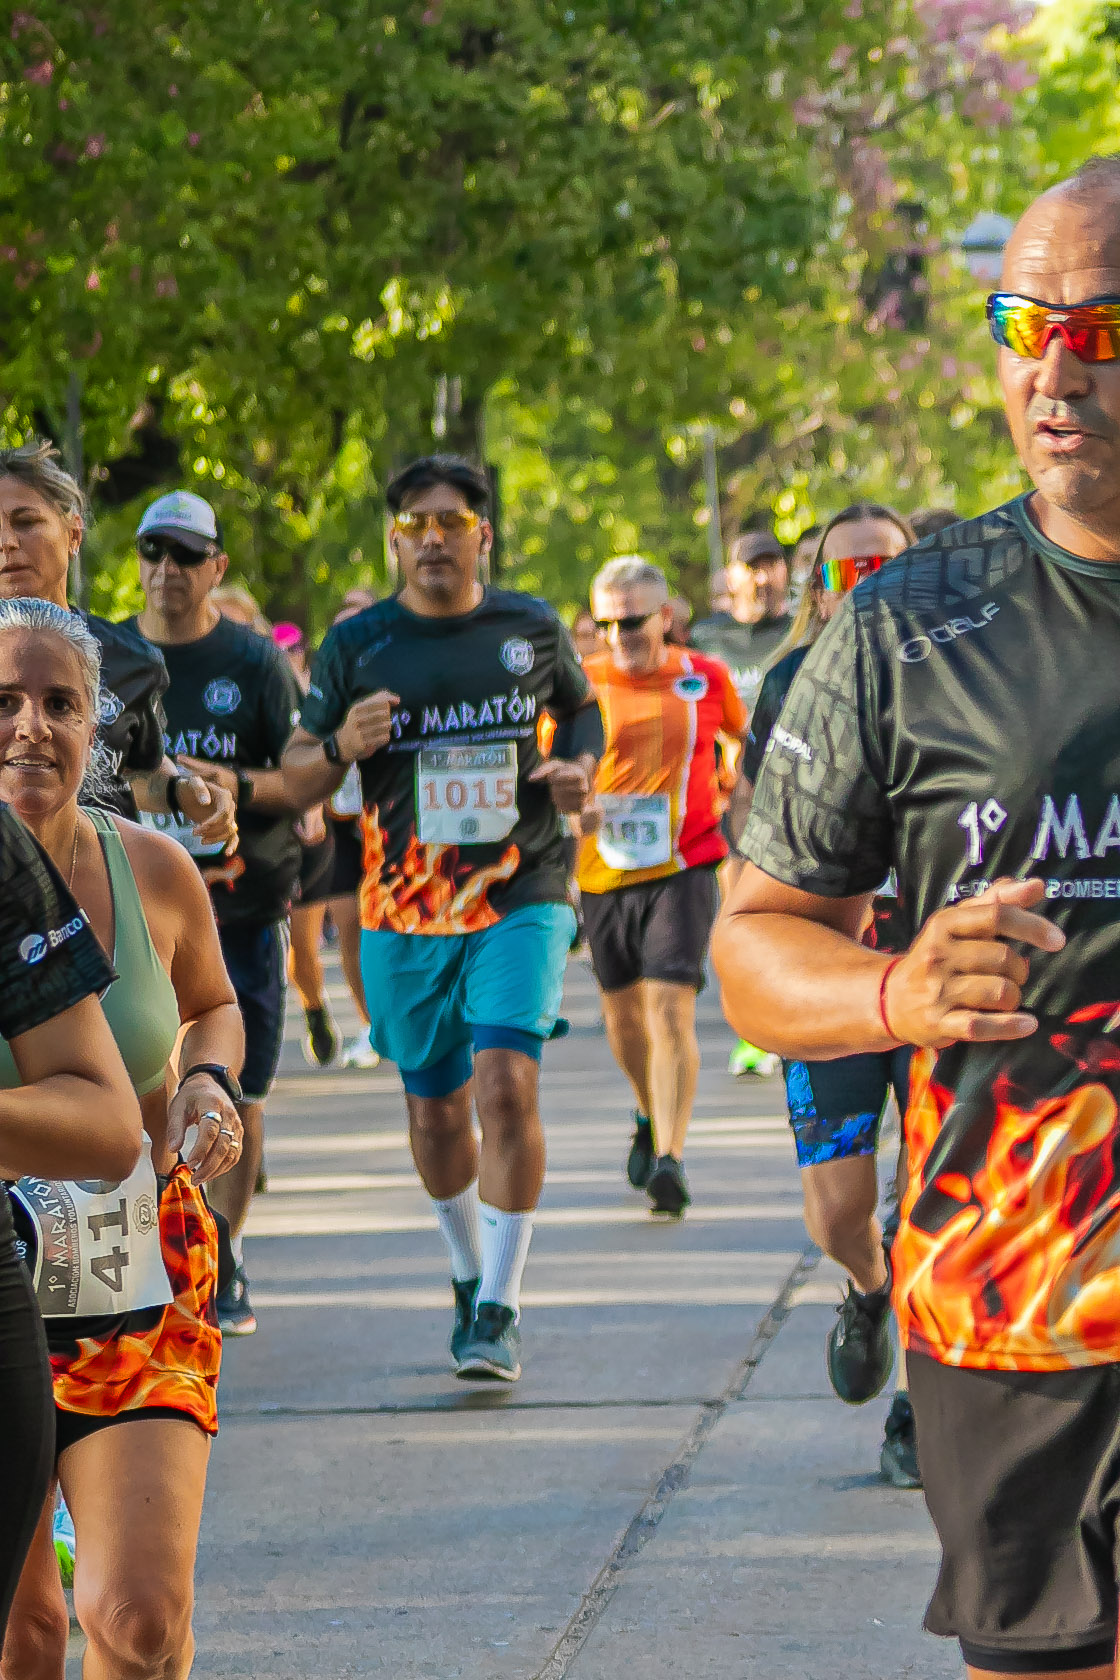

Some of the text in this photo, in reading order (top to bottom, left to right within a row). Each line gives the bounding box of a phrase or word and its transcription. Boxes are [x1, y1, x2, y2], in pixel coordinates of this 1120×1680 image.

[420, 685, 537, 735] MARATÓN
[423, 778, 516, 812] 1015
[957, 796, 1008, 866] 1º
[47, 917, 84, 948] Banco
[47, 1275, 66, 1293] 1º
